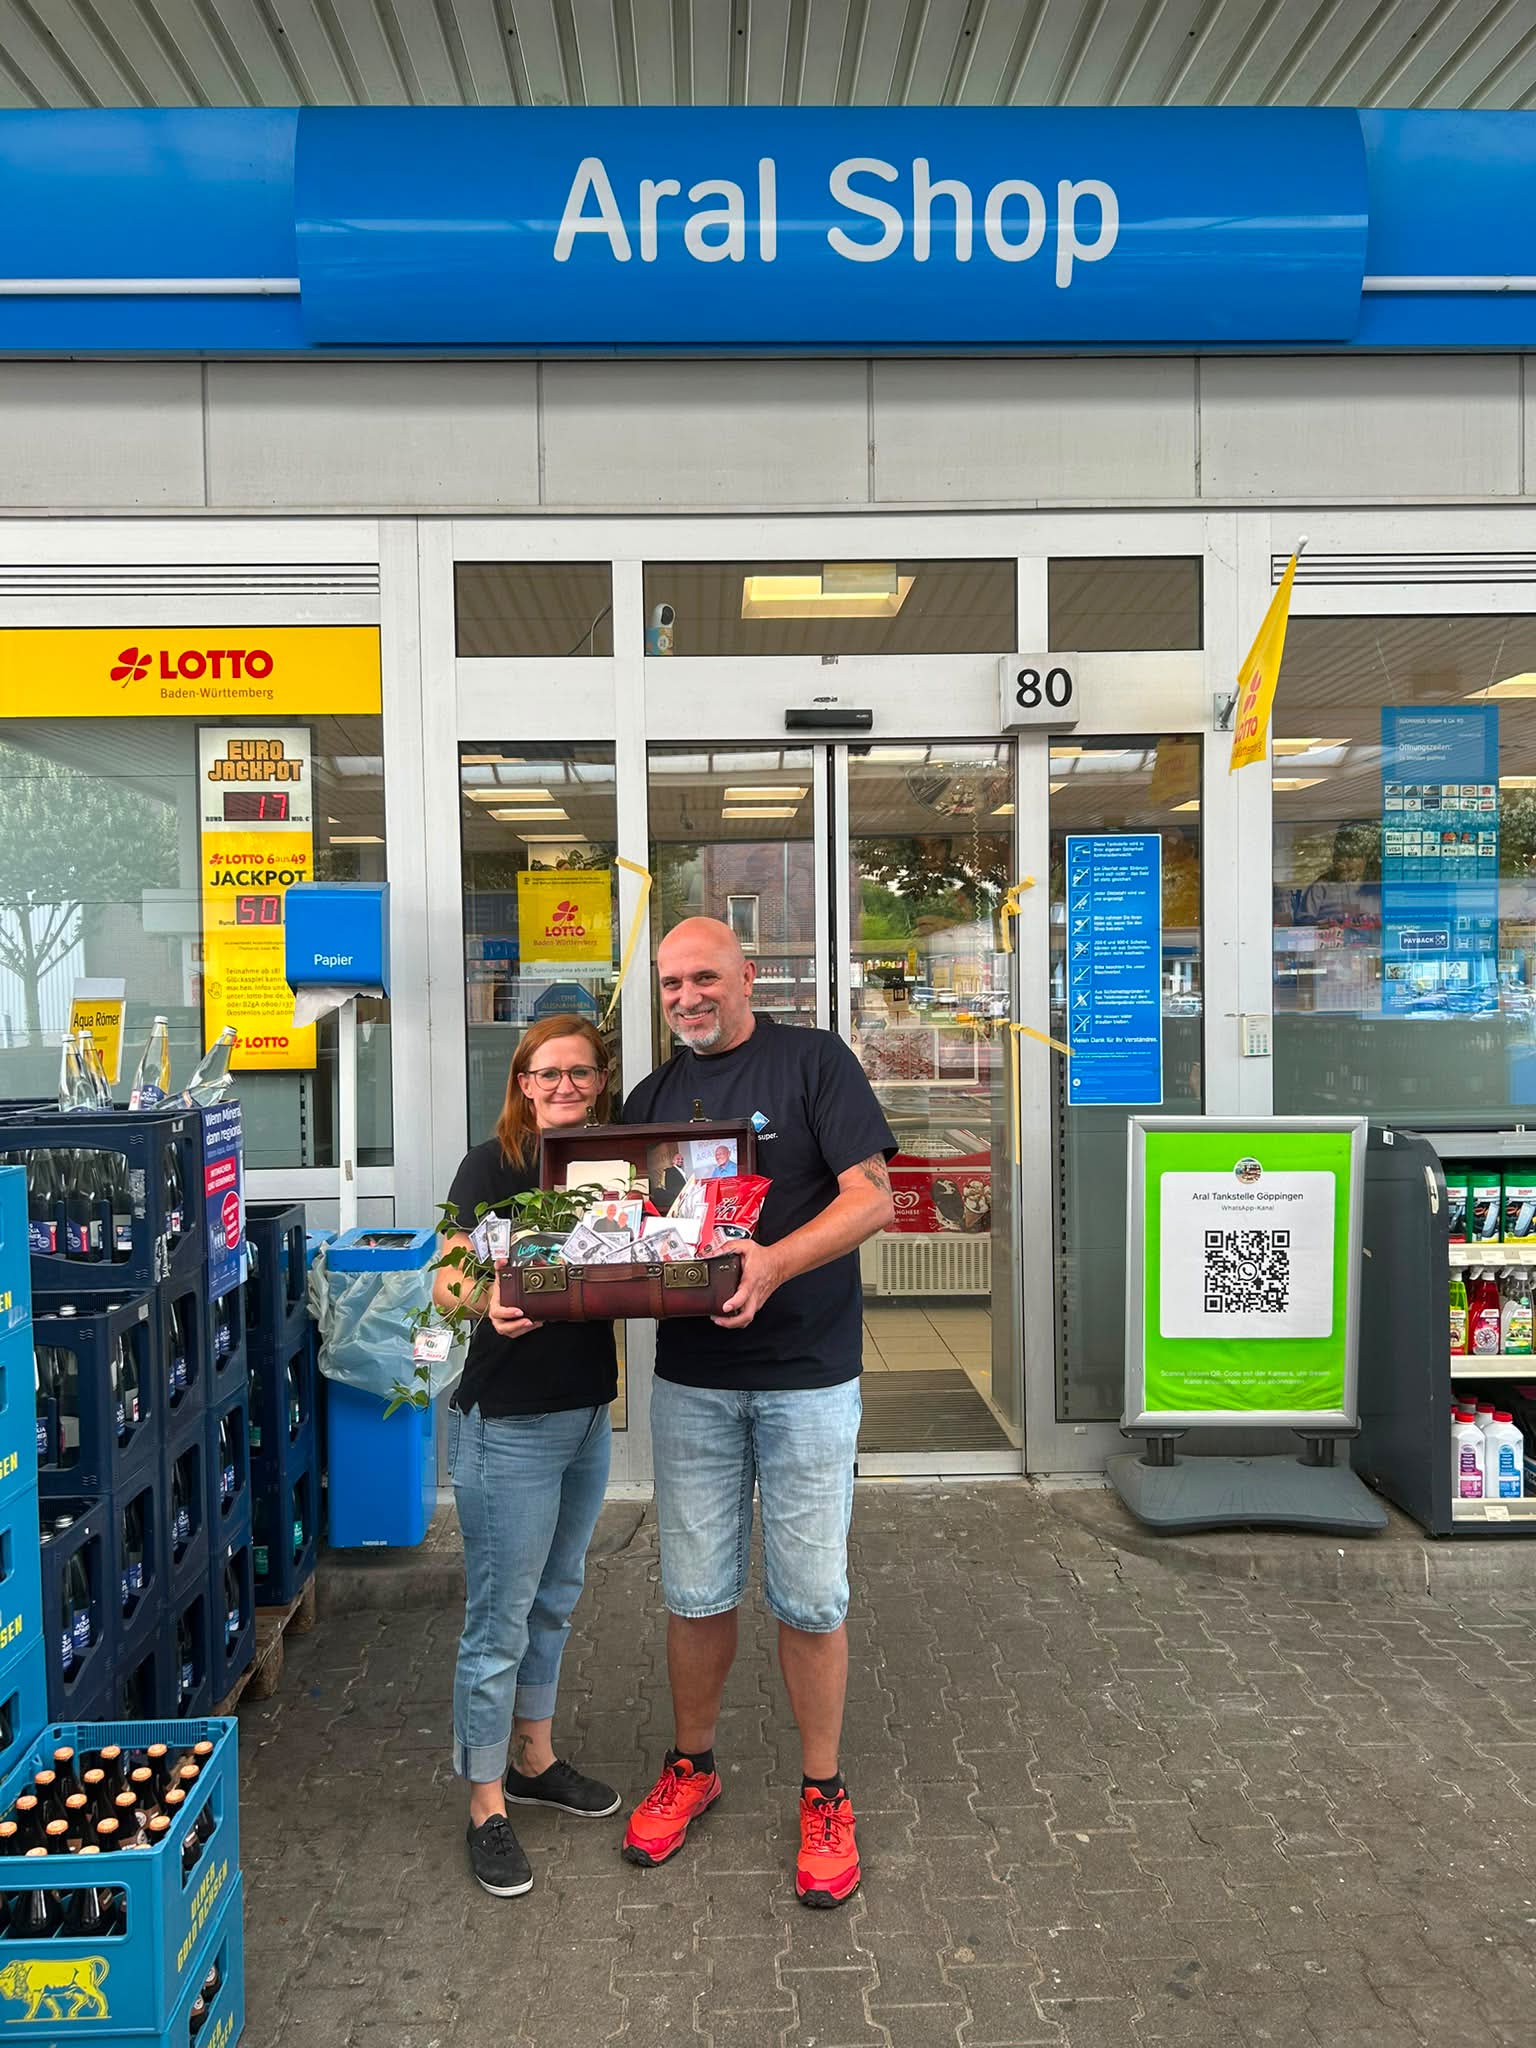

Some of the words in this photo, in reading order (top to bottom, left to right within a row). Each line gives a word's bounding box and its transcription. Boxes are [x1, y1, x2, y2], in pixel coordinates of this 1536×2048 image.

[553, 157, 776, 262] Aral
[827, 157, 1119, 289] Shop
[160, 650, 274, 680] LOTTO
[160, 686, 274, 700] Baden-Württemberg
[1016, 668, 1073, 708] 80
[227, 740, 284, 760] EURO
[208, 760, 303, 781] JACKPOT
[259, 795, 287, 820] 17
[226, 854, 264, 865] LOTTO
[210, 870, 306, 886] JACKPOT
[240, 897, 278, 923] 50
[545, 926, 586, 936] LOTTO
[314, 952, 353, 968] Papier
[73, 1012, 94, 1030] Aqua
[96, 1012, 120, 1026] Römer
[245, 1037, 289, 1048] LOTTO
[757, 1132, 779, 1141] super.
[1192, 1192, 1210, 1201] Aral
[1212, 1192, 1255, 1201] Tankstelle
[1257, 1191, 1304, 1203] Göppingen
[191, 1861, 216, 1921] ULMER
[177, 1919, 198, 1973] GOLD
[198, 1858, 228, 1929] OCHSEN
